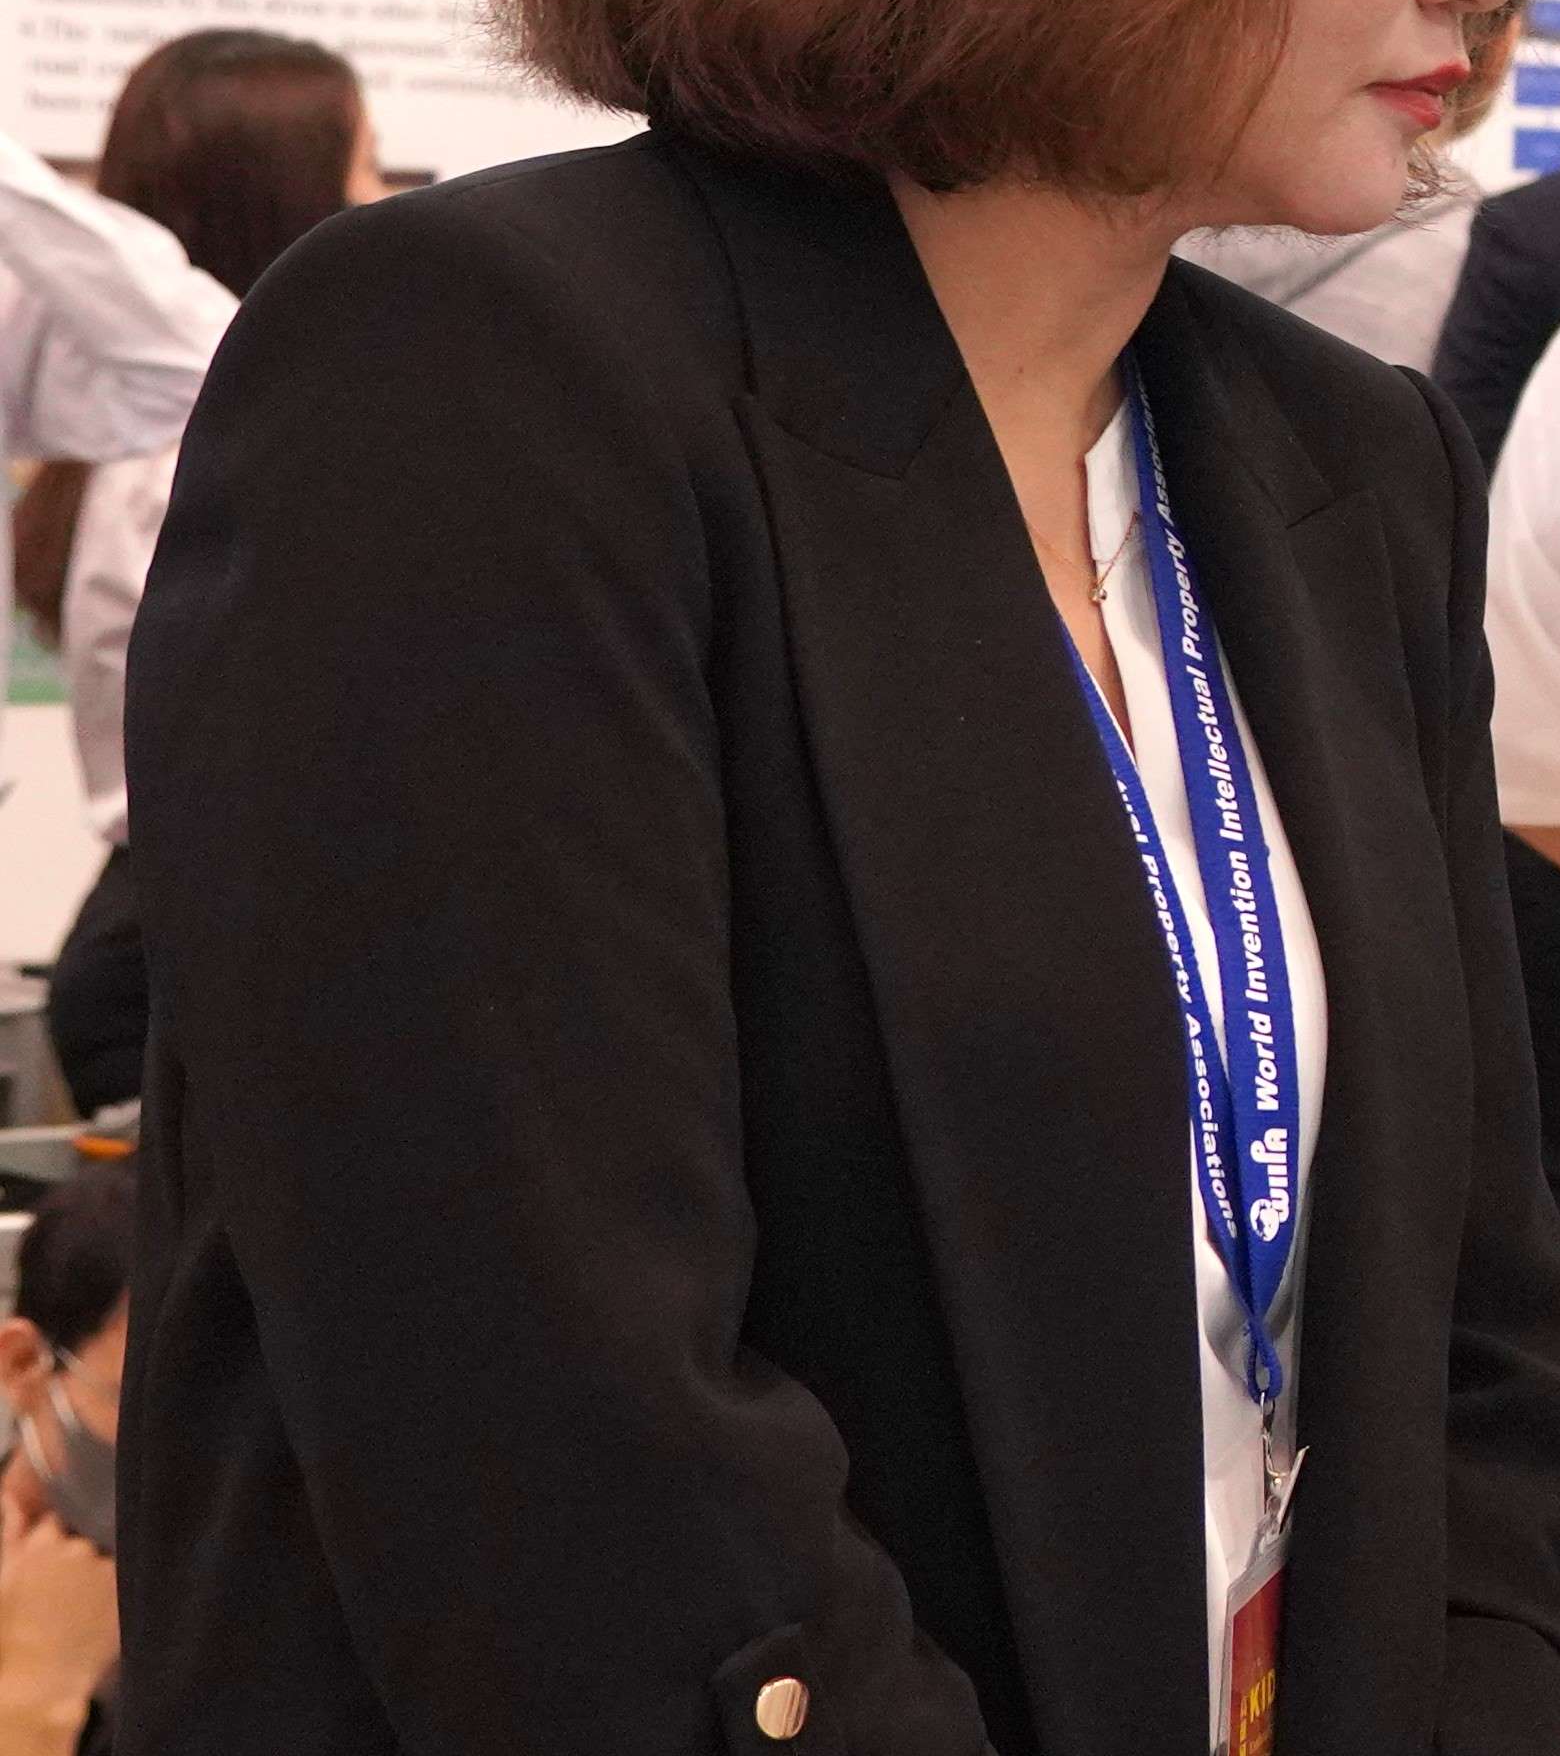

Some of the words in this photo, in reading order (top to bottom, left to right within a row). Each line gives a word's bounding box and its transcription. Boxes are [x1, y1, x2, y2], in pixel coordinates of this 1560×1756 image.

[1165, 526, 1204, 662] Property
[1185, 664, 1244, 842] Intellectual
[1229, 851, 1270, 1004] Invention
[1141, 854, 1192, 1005] Property
[1184, 1012, 1239, 1240] Associations
[1250, 1010, 1280, 1112] World
[1249, 1667, 1276, 1726] KID
